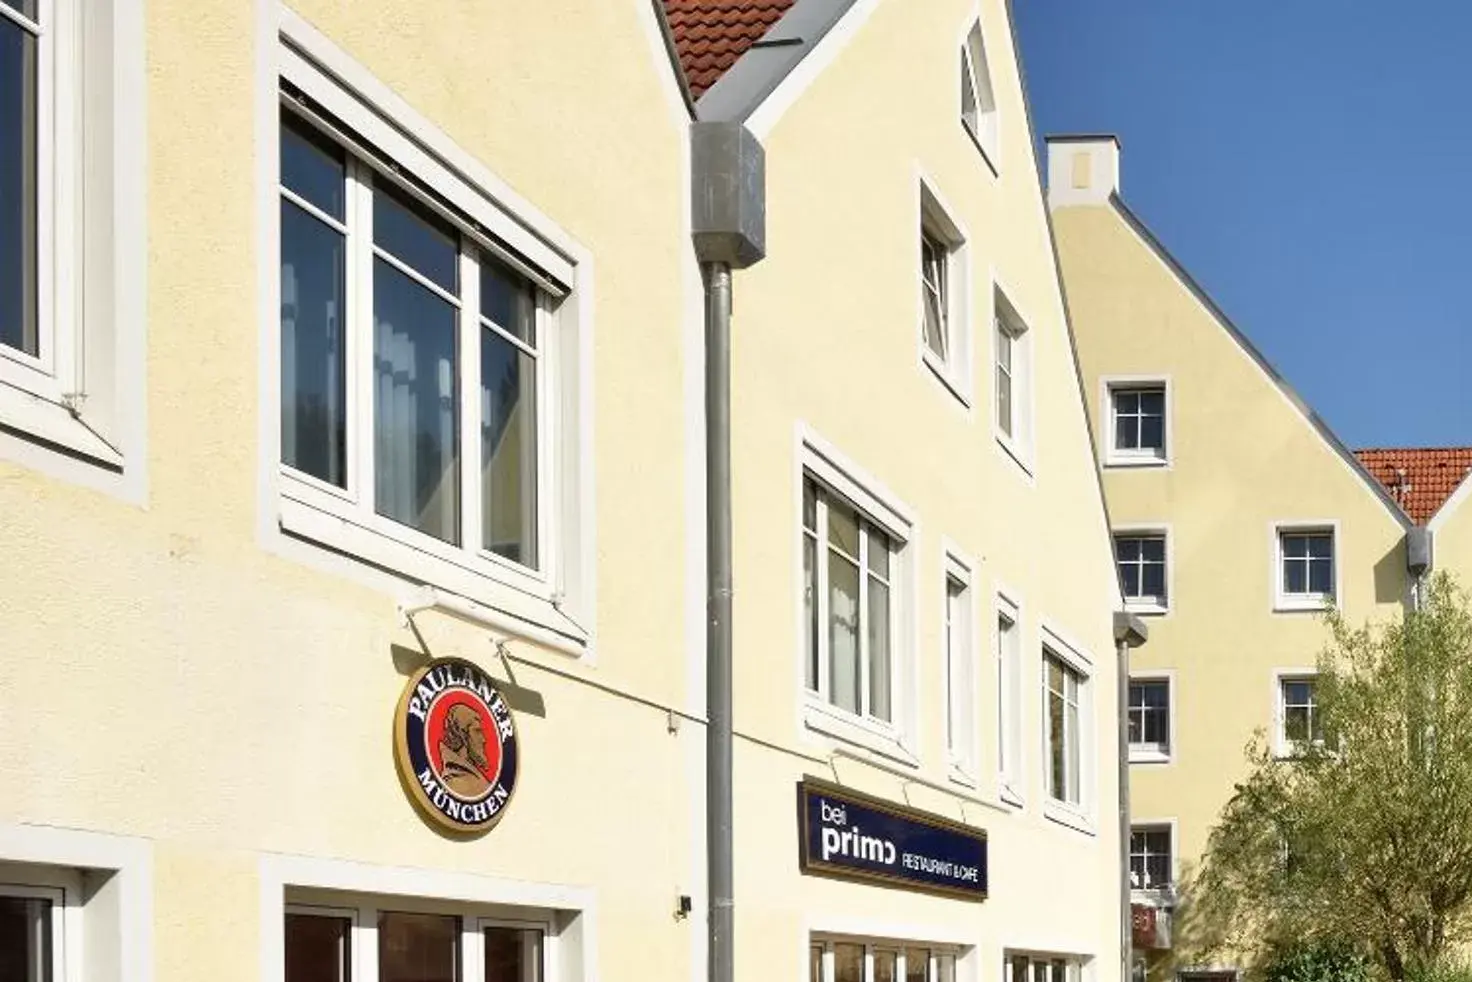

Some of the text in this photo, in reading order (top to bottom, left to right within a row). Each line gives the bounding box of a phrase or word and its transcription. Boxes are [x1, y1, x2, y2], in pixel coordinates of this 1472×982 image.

[409, 664, 514, 742] PAULANER
[417, 768, 510, 823] MÜNCHEN
[821, 799, 847, 825] bei
[902, 853, 953, 876] RESTAURANT
